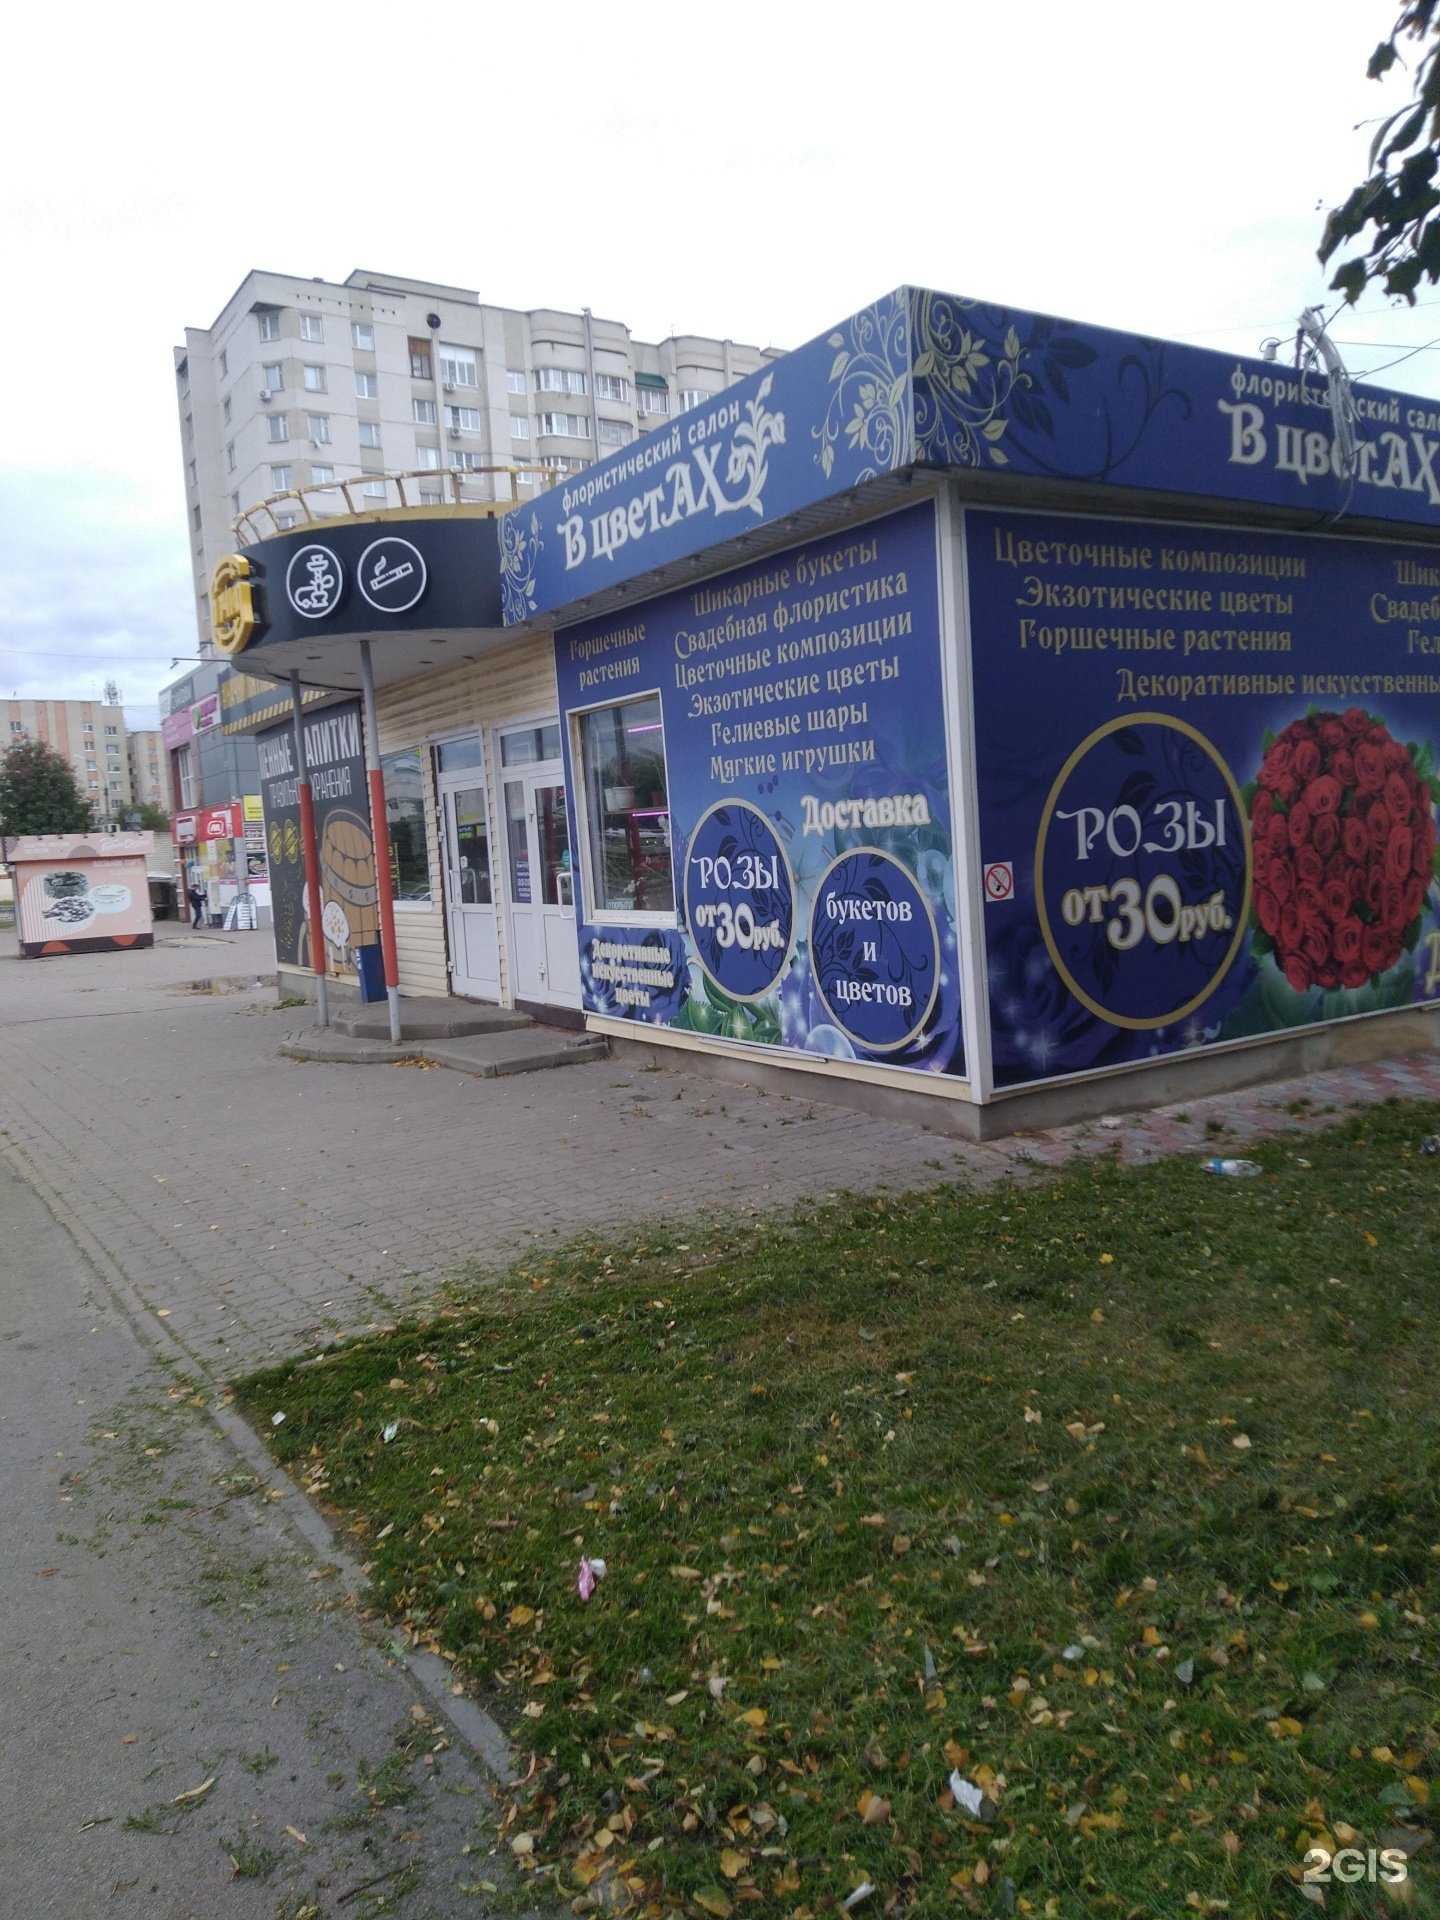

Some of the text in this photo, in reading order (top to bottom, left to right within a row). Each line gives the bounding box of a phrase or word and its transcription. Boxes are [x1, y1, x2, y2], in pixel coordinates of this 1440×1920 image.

[1230, 363, 1400, 424] флористский
[1217, 398, 1267, 465] В
[562, 401, 740, 513] флористический салон
[556, 513, 588, 571] В
[994, 527, 1306, 580] Цветочные композиции
[690, 538, 879, 618] Шикарные букеты
[1016, 575, 1293, 617] Экзотические цветы
[674, 571, 908, 660] Свадебная флористика
[1018, 617, 1292, 656] Горшечные растения
[569, 621, 647, 661] Горшечные
[675, 611, 913, 690] Цветочные композиции
[578, 655, 641, 691] растения
[687, 655, 901, 719] Экзотические цветы
[1116, 667, 1296, 701] Декоративные
[295, 711, 360, 768] АПИТКИ
[711, 701, 869, 747] Гелиевые шары
[710, 738, 875, 784] Мягкие игрушки
[800, 793, 932, 838] Доставка
[1055, 798, 1228, 861] РОЗЫ
[691, 855, 780, 890] РОЗЫ
[825, 891, 914, 925] букетов
[862, 940, 877, 962] и
[835, 978, 913, 1008] цветов
